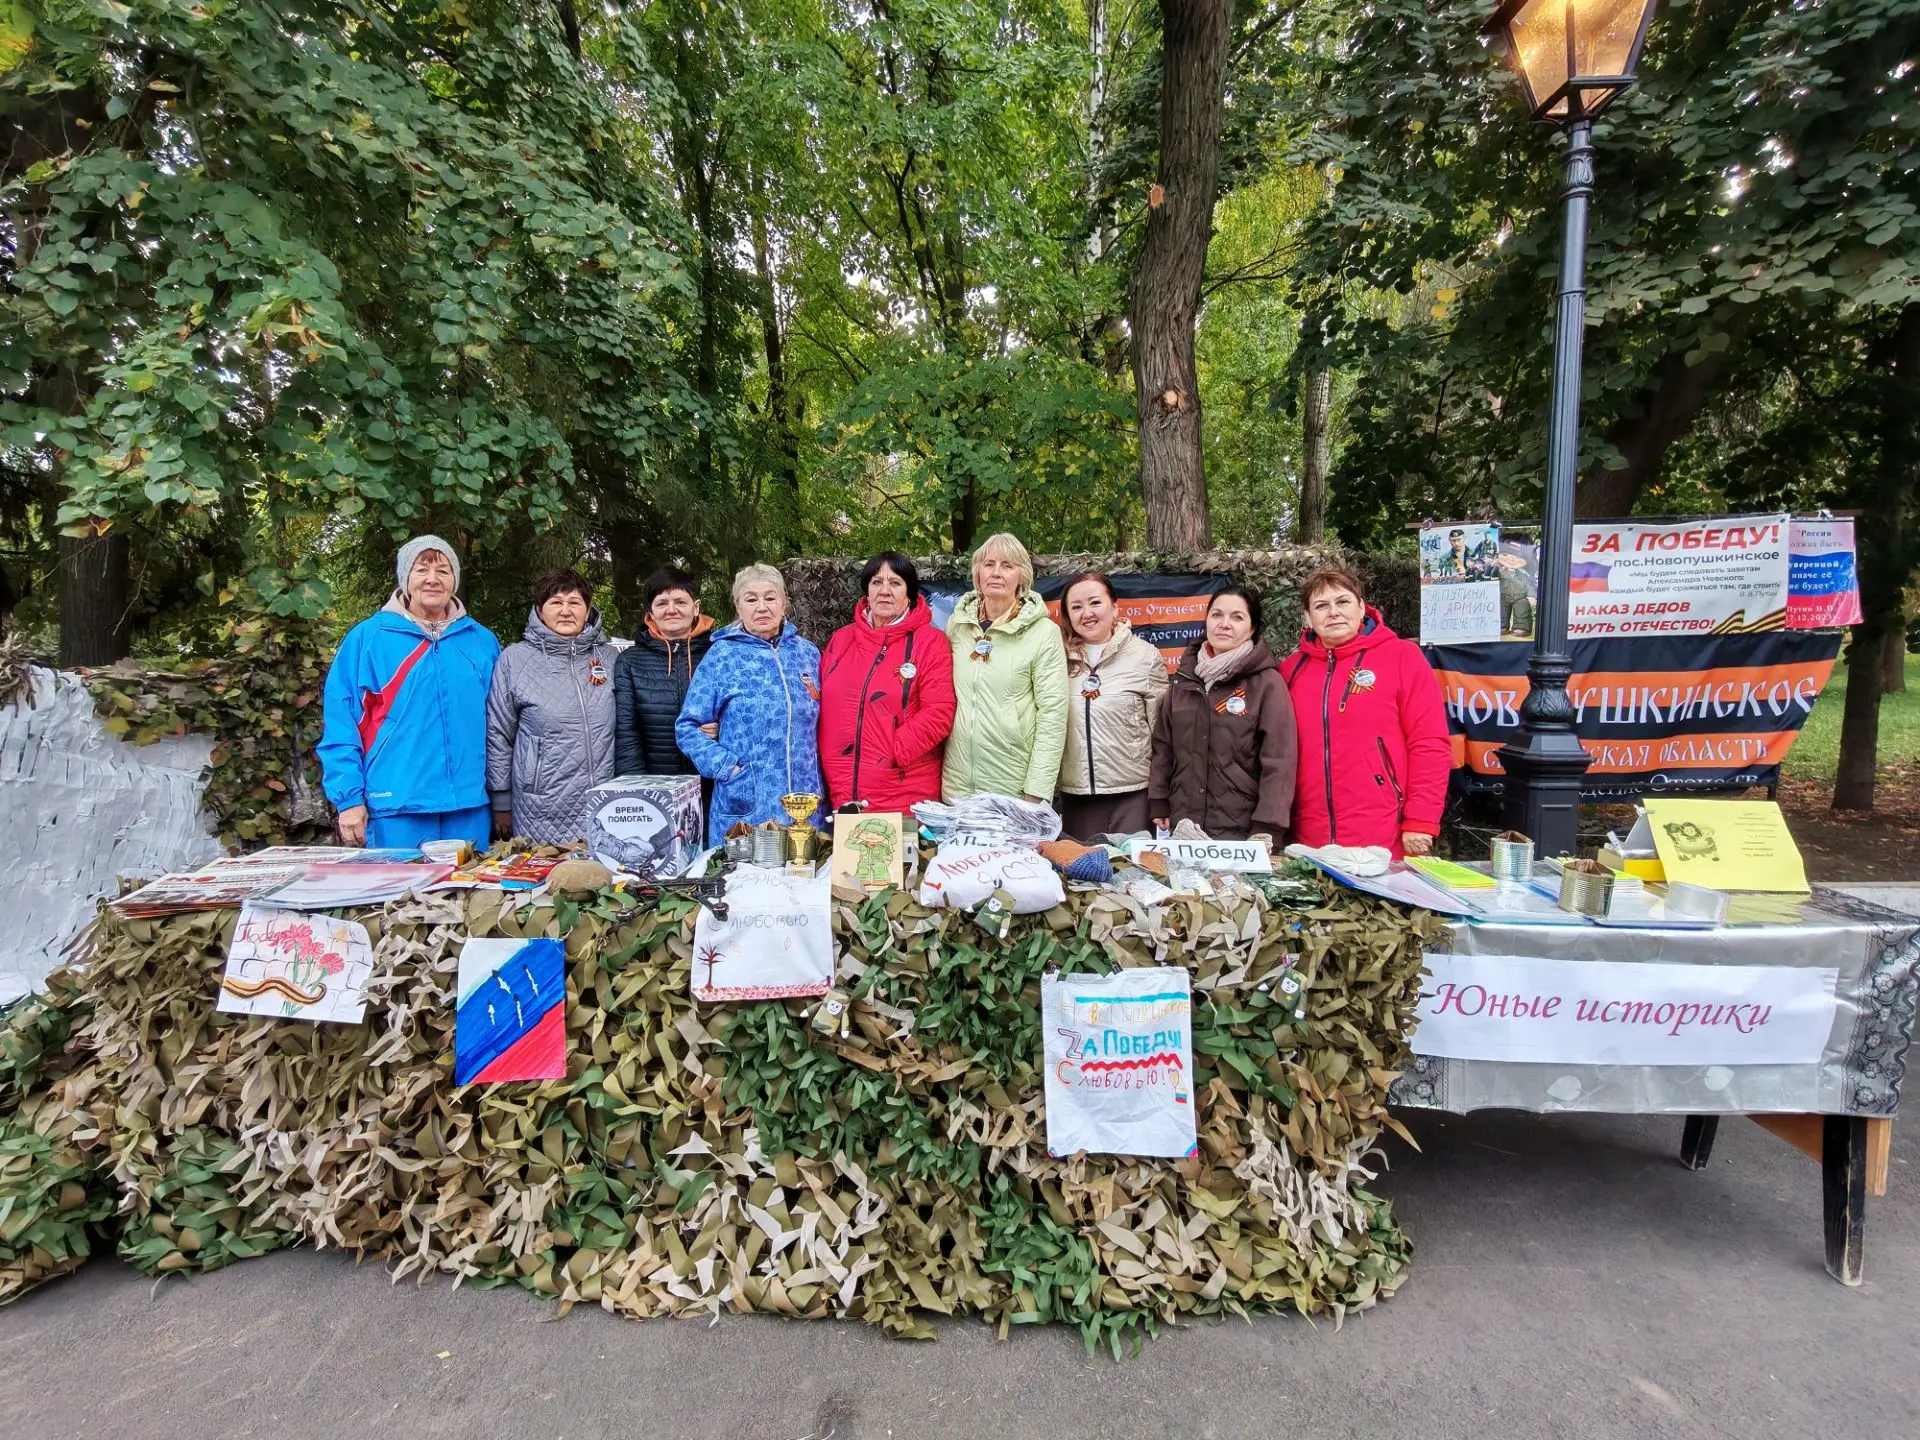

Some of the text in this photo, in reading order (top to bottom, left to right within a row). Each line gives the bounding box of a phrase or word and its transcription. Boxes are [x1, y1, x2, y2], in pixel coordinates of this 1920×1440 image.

[1581, 525, 1780, 553] ЗА ПОБЕДУ!
[1649, 570, 1677, 578] будем
[1678, 568, 1725, 577] следовать
[1726, 566, 1761, 574] заветам
[1648, 576, 1701, 585] Александра
[1646, 585, 1675, 594] будет
[1676, 584, 1718, 592] сражаться
[1575, 601, 1691, 616] НАКАЗ ДЕДОВ
[1567, 619, 1716, 634] РНУТЬ ОТЕЧЕСТВО!
[1446, 677, 1817, 727] НОВУШКИНСКОЕ
[615, 806, 644, 814] ВРЕМЯ
[608, 815, 653, 823] ПОМОГАТЬ
[1178, 845, 1257, 862] Победу
[1430, 983, 1773, 1037] Юные историки
